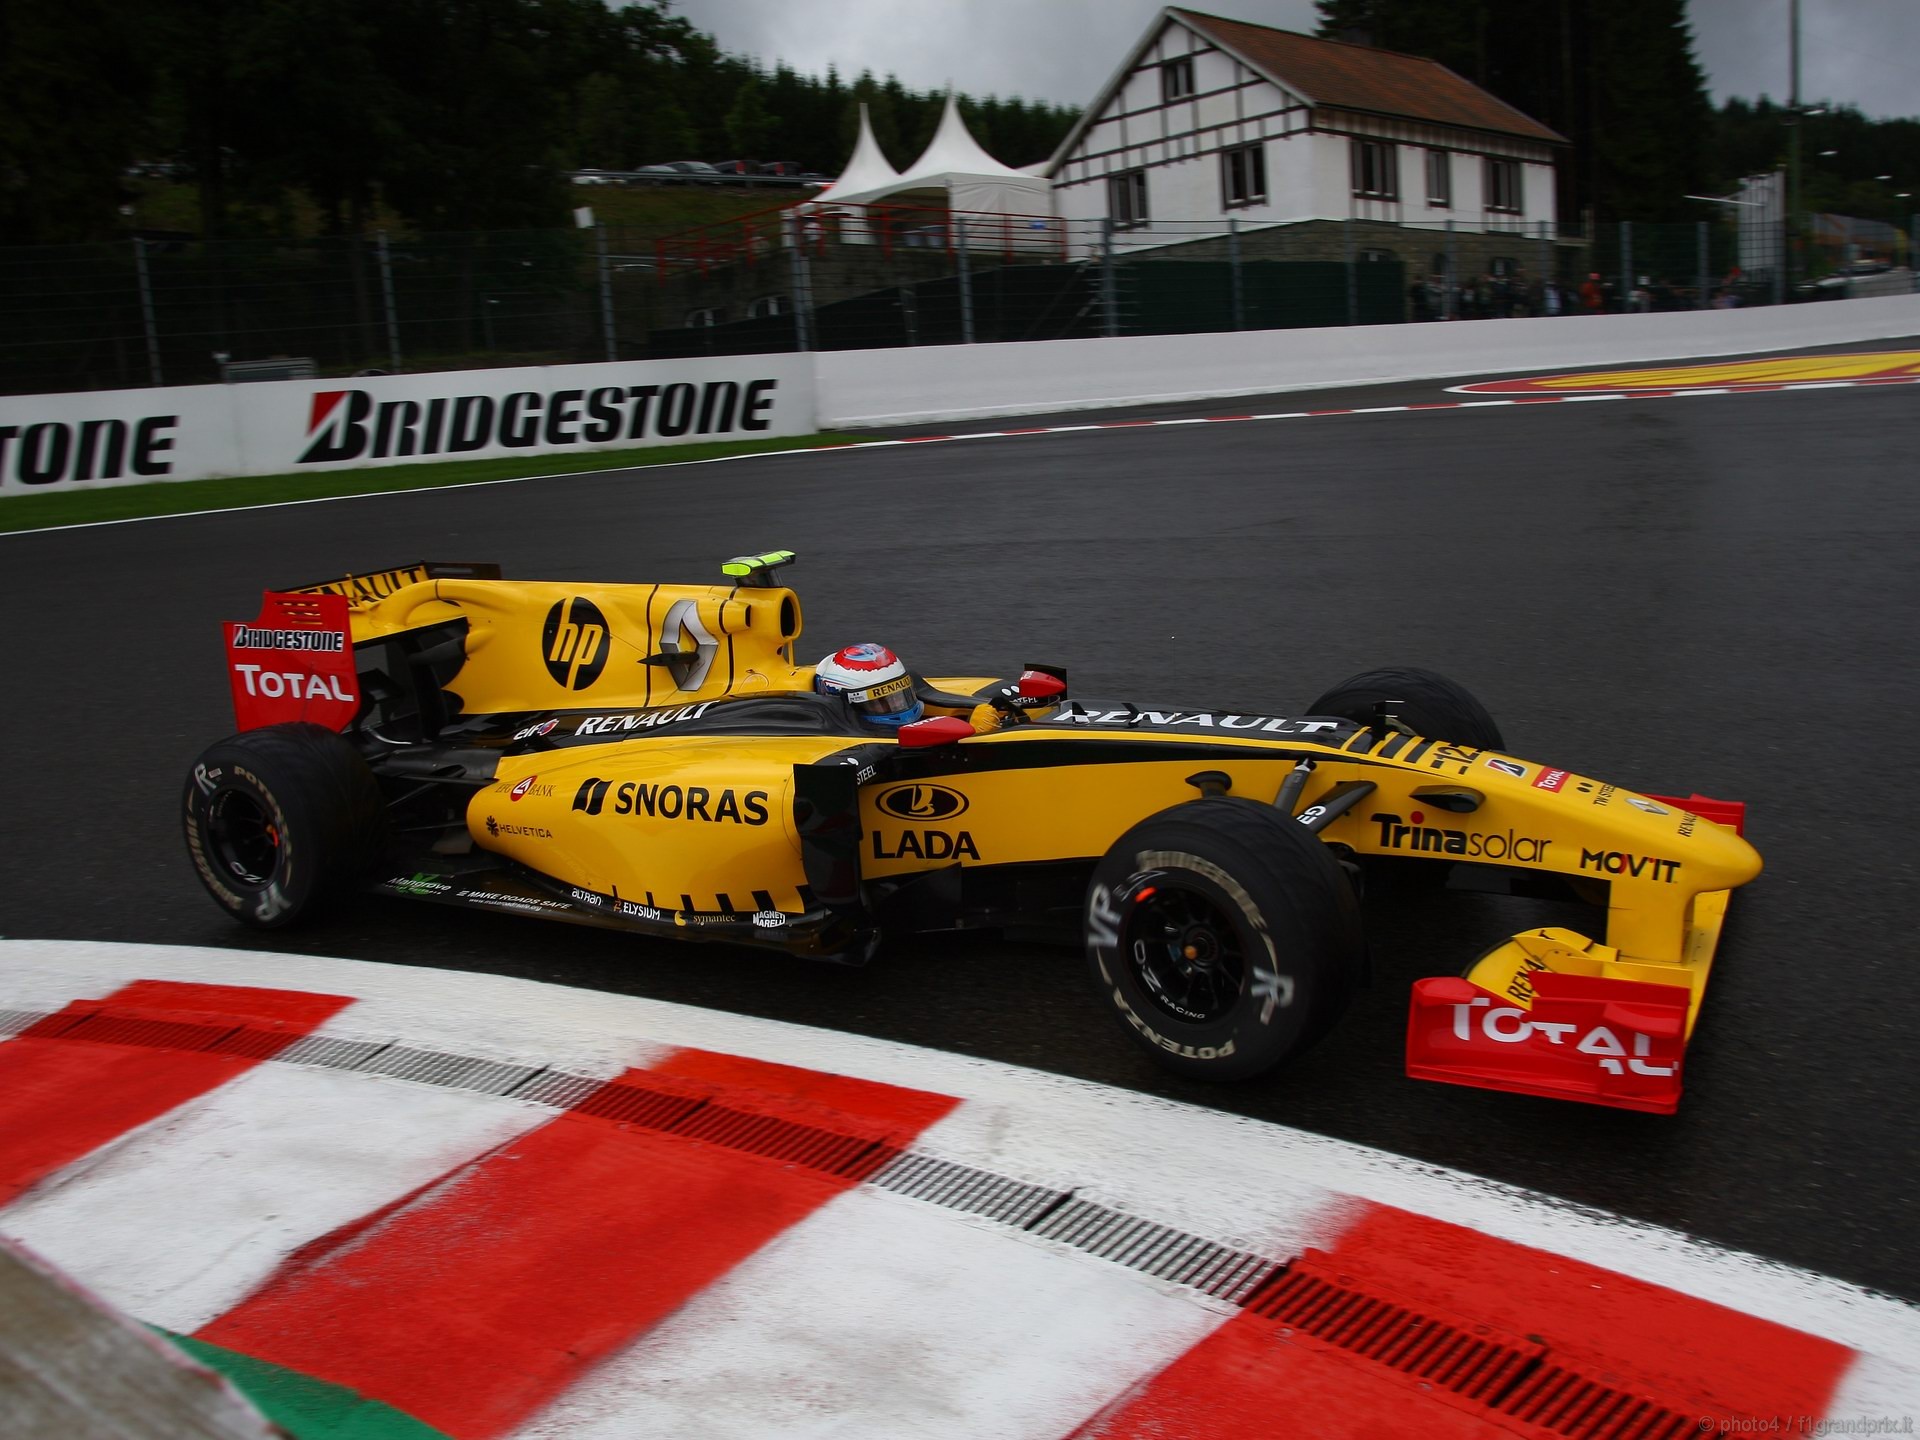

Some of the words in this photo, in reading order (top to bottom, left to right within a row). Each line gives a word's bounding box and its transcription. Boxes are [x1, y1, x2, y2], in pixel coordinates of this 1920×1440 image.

[296, 379, 777, 463] BRIDGESTONE
[233, 624, 344, 652] BRIDGESTONE
[550, 597, 604, 690] hp
[235, 664, 354, 702] TOTAL
[574, 700, 720, 736] RENAULT
[1053, 710, 1338, 733] RENAULT
[1537, 770, 1566, 789] TOTAL
[615, 782, 770, 826] SNORAS
[499, 824, 553, 839] HELVETICA
[872, 830, 982, 861] LADA
[467, 890, 501, 900] MAKE
[500, 894, 541, 905] ROADS
[540, 900, 573, 910] SAFE
[623, 901, 661, 920] ELYSIUM
[693, 914, 736, 925] symantec
[1160, 994, 1206, 1020] RACING
[1452, 998, 1679, 1077] TOTAL
